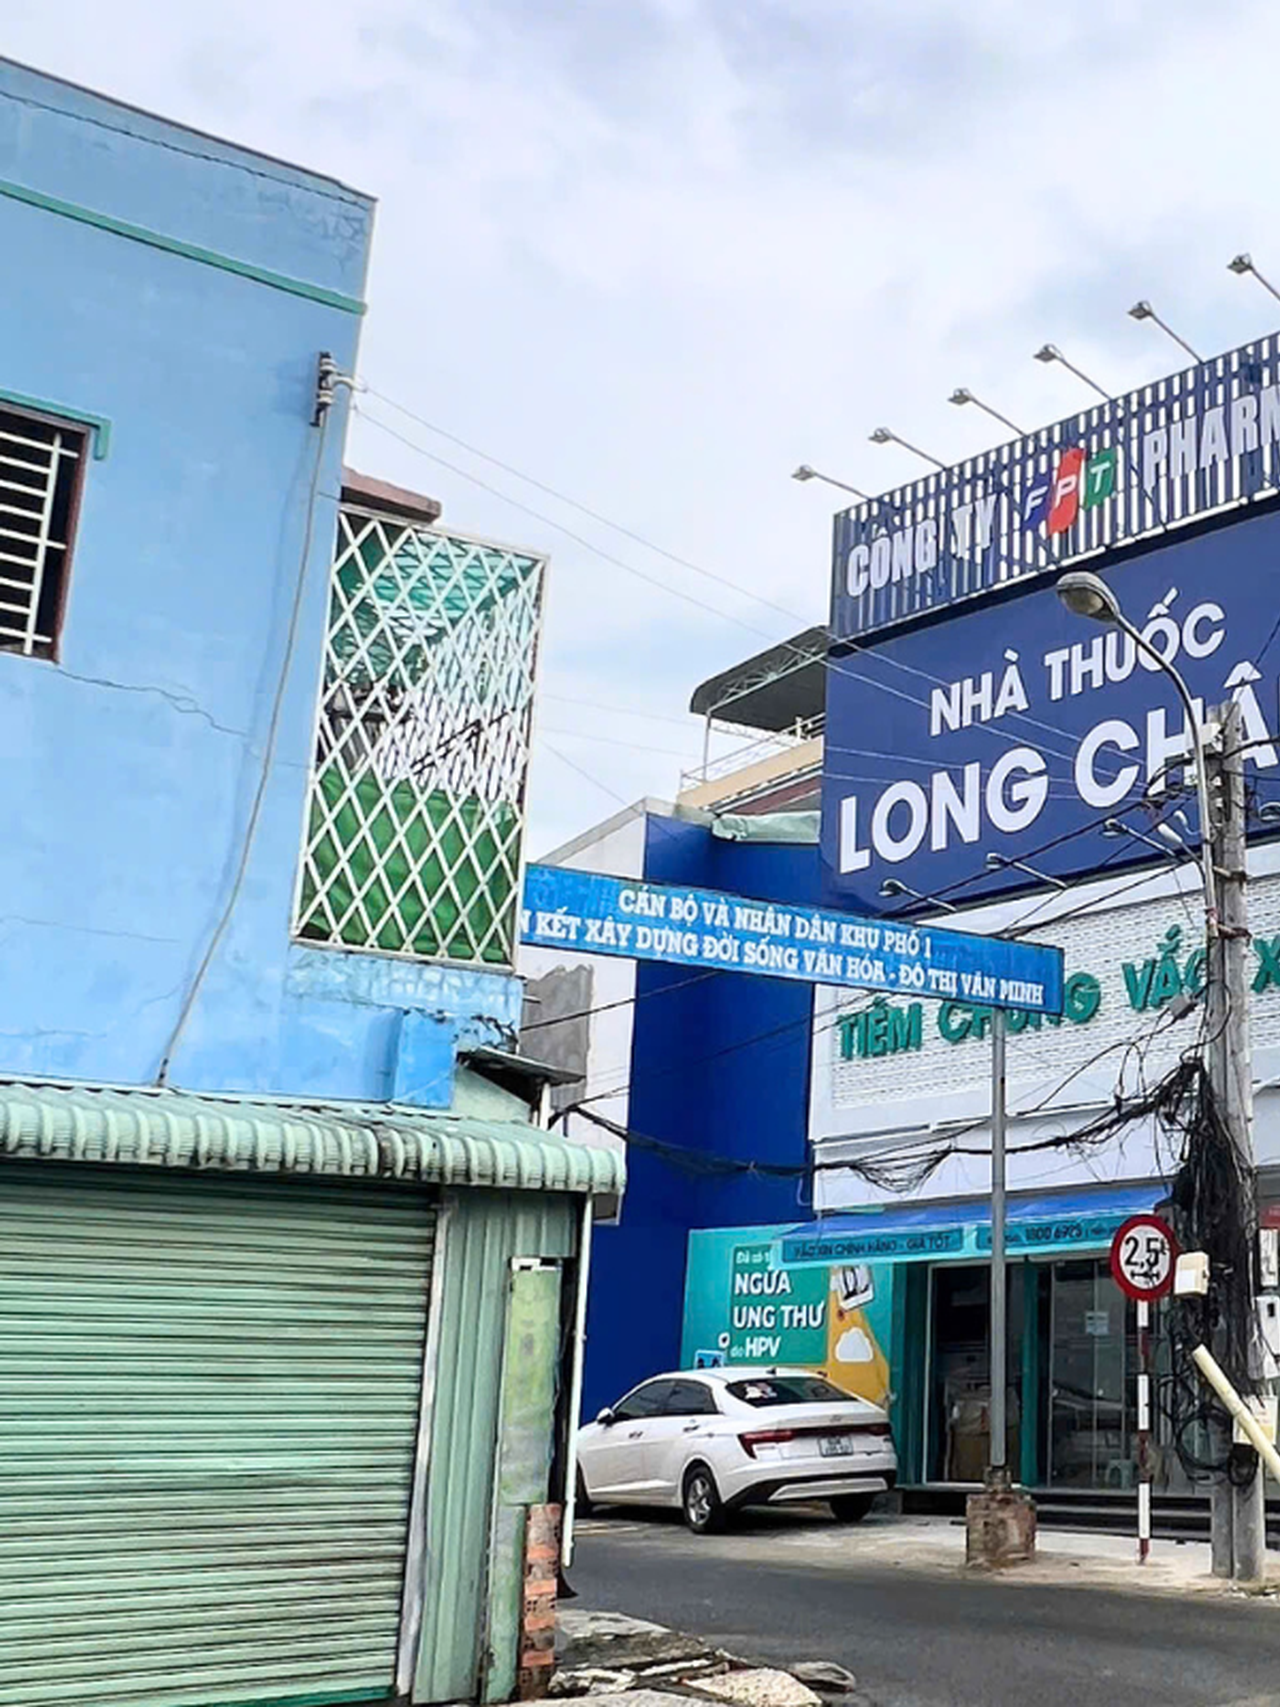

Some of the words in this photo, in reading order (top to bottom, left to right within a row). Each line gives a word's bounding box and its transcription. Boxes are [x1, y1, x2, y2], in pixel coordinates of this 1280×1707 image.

[847, 524, 937, 597] CÔNG
[952, 497, 997, 559] TY
[1020, 448, 1117, 536] FPT
[930, 650, 1030, 736] NHÀ
[1043, 587, 1226, 700] THUỐC
[838, 747, 1049, 874] LONG
[535, 904, 582, 940] KẾT
[584, 914, 632, 947] XÂY
[635, 924, 698, 962] DỰNG
[702, 932, 742, 962] ĐỜI
[744, 935, 800, 972] SỐNG
[846, 956, 886, 982] HÓA
[900, 962, 926, 986] ĐÔ
[928, 968, 958, 998] THỊ
[998, 979, 1045, 1006] MINH
[619, 885, 665, 918] CÁN
[669, 892, 699, 923] BỘ
[702, 896, 730, 928] VÀ
[734, 905, 791, 937] NHÂN
[795, 913, 836, 944] DÂN
[840, 922, 880, 951] KHU
[883, 927, 921, 957] PHỐ
[924, 935, 933, 959] 1
[836, 994, 925, 1062] TIÊM
[733, 1305, 777, 1329] UNG
[780, 1300, 826, 1329] THƯ
[745, 1336, 782, 1358] HPV
